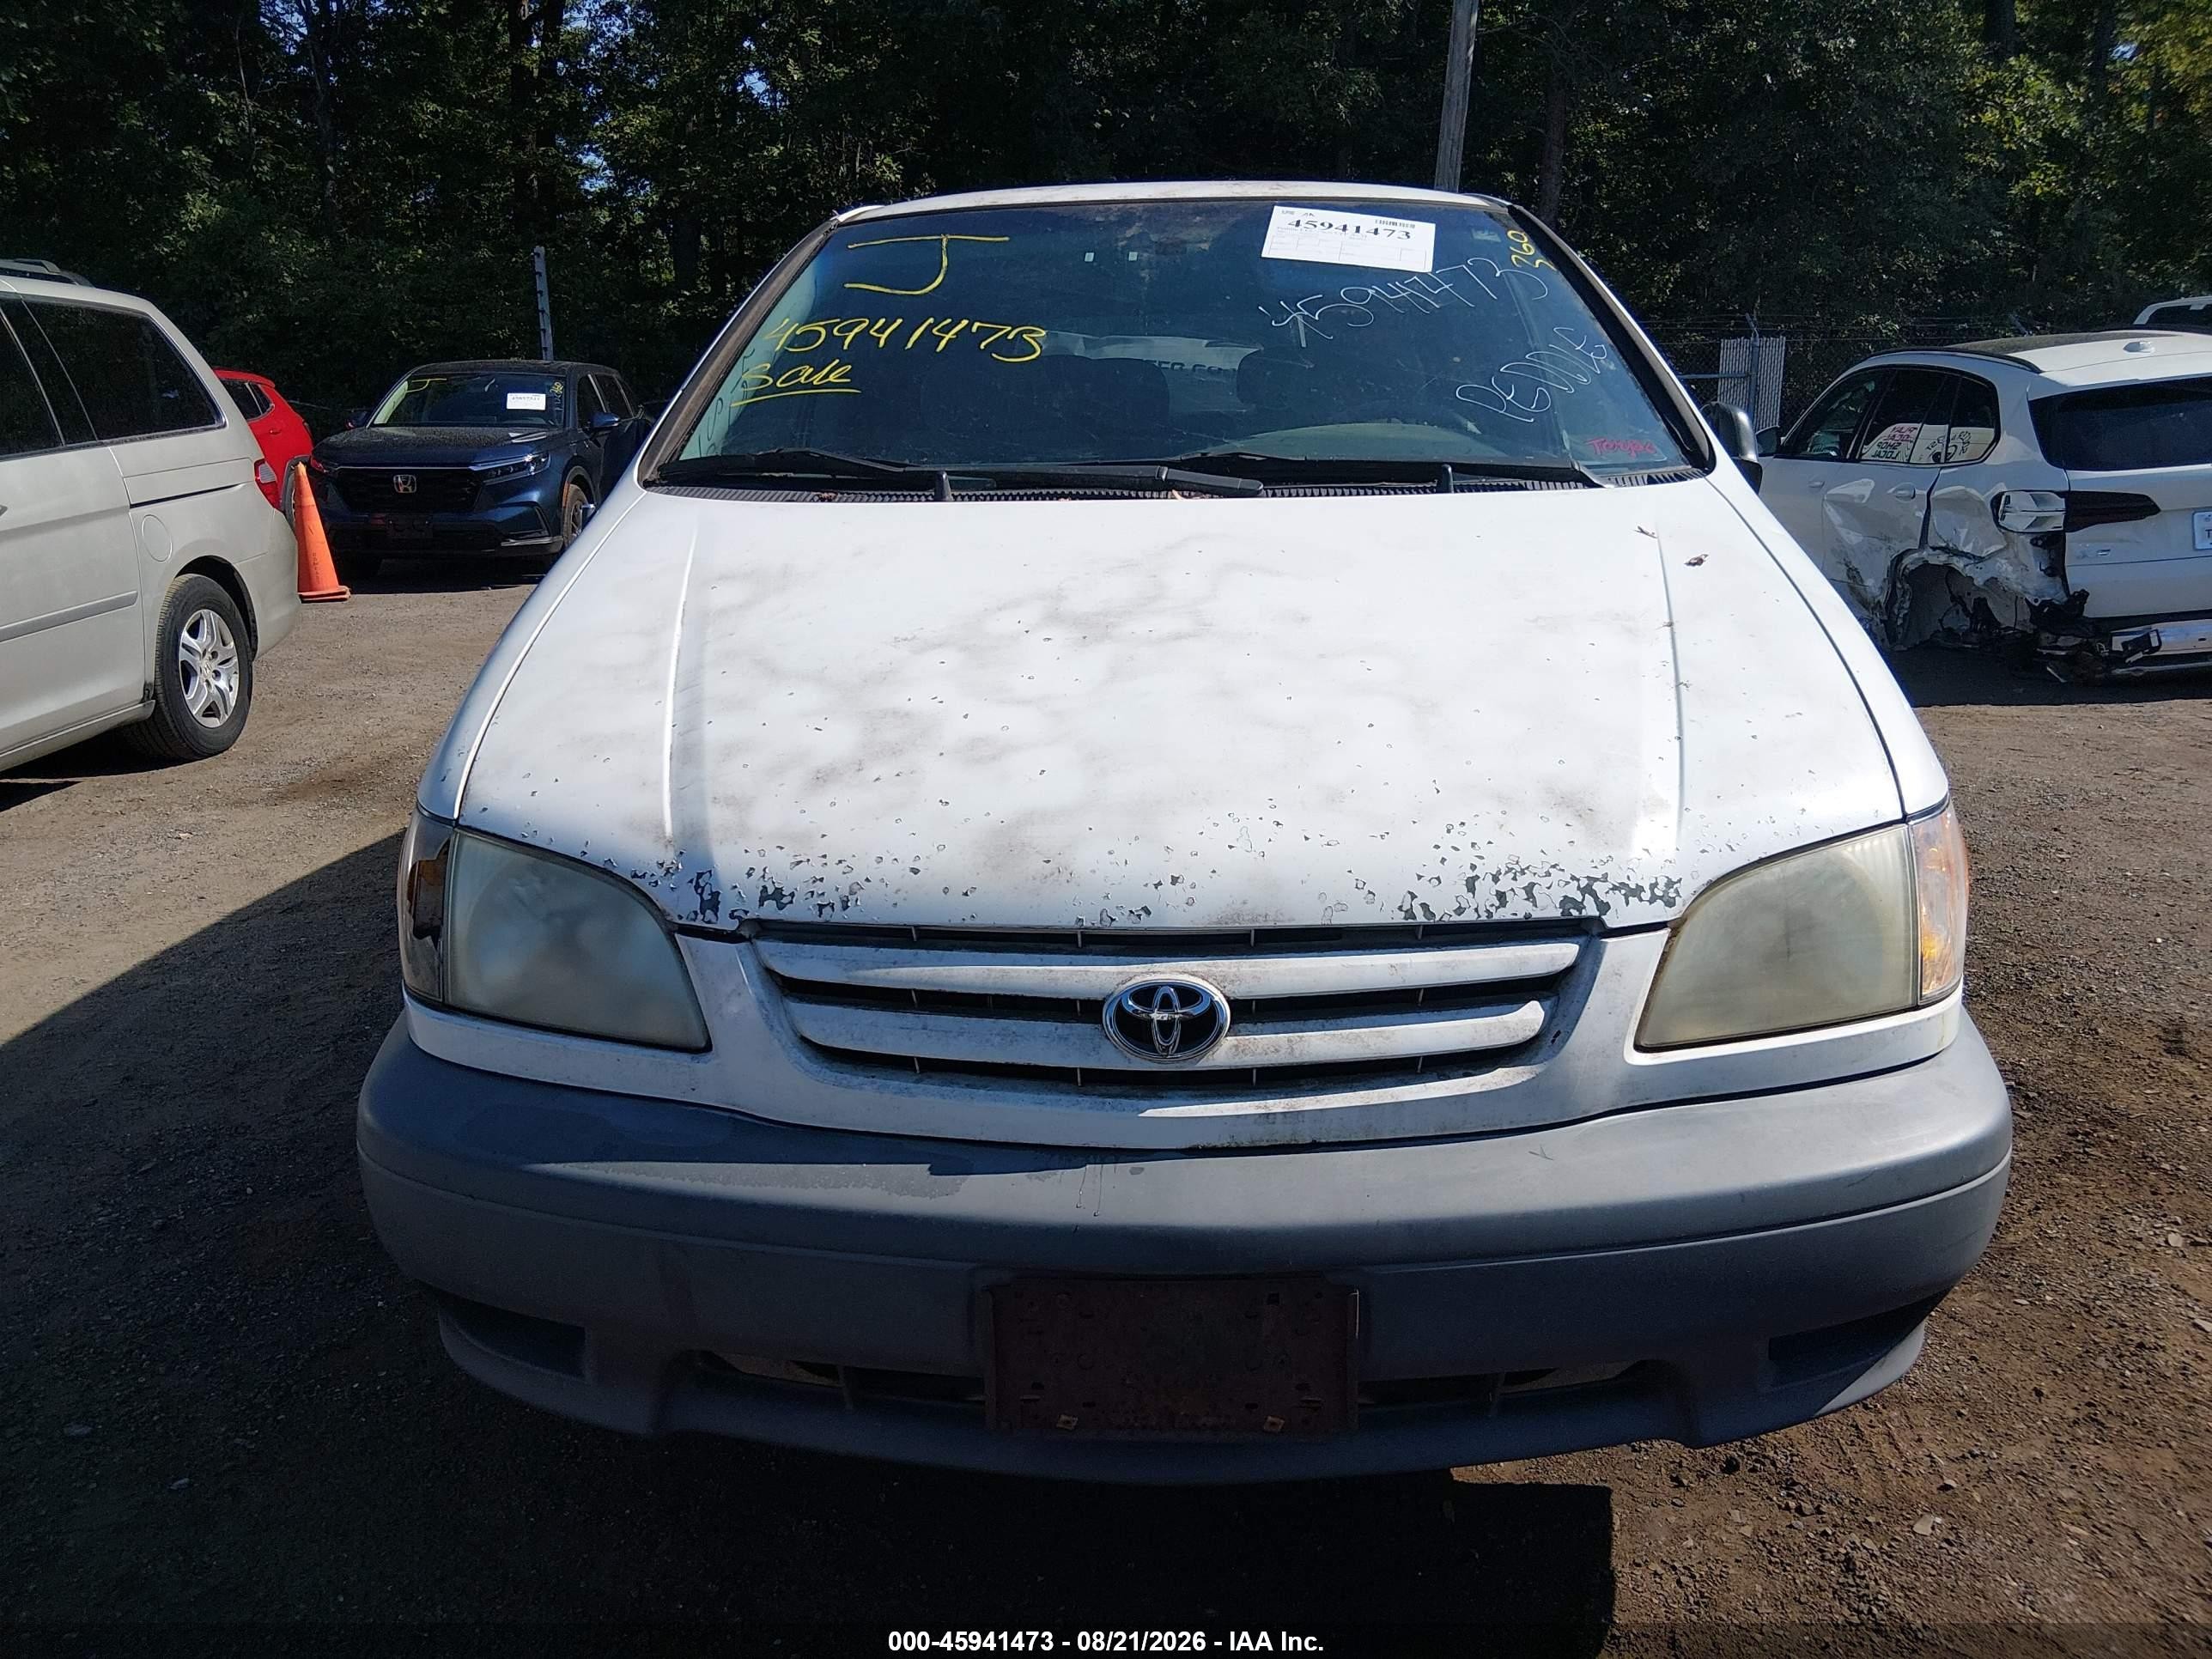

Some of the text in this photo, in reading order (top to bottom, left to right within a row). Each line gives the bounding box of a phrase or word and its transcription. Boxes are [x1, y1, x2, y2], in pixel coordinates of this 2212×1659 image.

[1288, 219, 1411, 240] 45941473
[843, 234, 1010, 295] J
[763, 316, 1048, 363] 45941473
